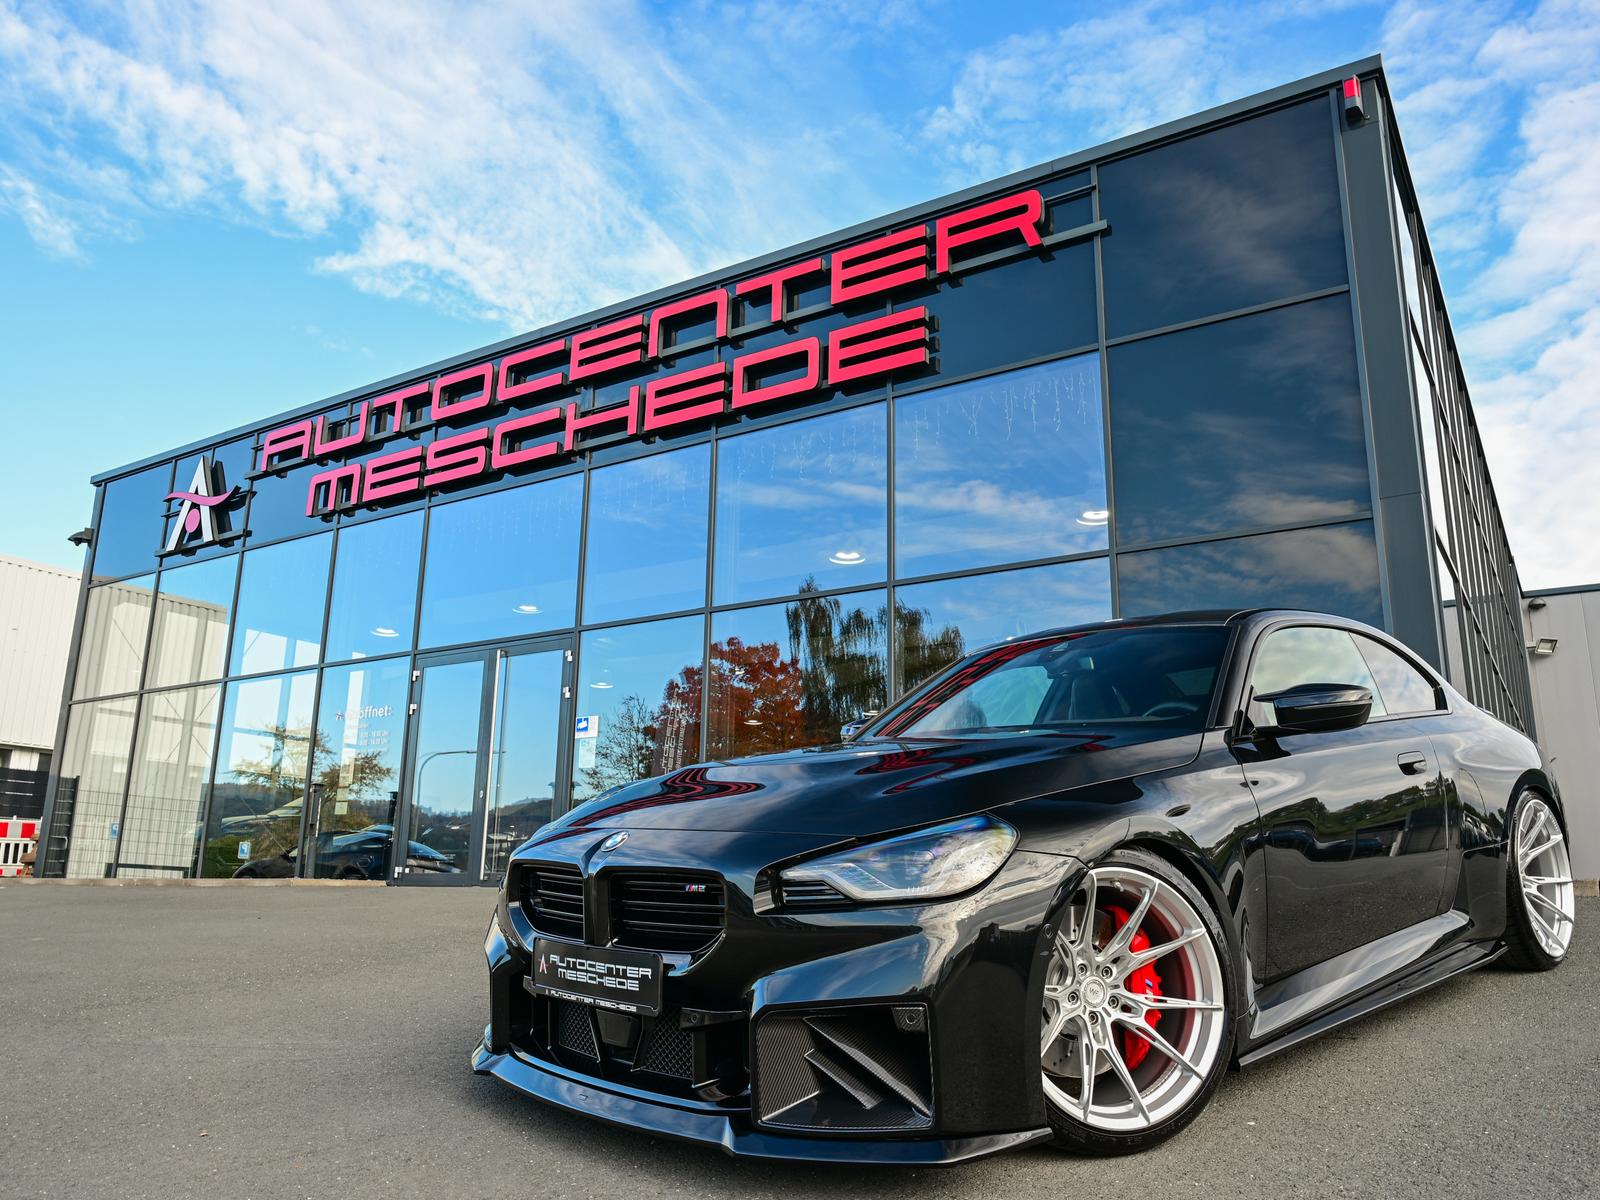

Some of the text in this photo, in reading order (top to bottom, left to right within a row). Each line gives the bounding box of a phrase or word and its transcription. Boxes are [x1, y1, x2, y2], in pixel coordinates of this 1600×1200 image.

[261, 189, 1044, 471] AUTOCENTER
[305, 305, 928, 517] MESCHEDE
[549, 954, 652, 980] AUTOCENTER
[557, 968, 640, 991] MESCHEDE
[550, 990, 637, 1012] AUTOCENTER MESCHEDE
